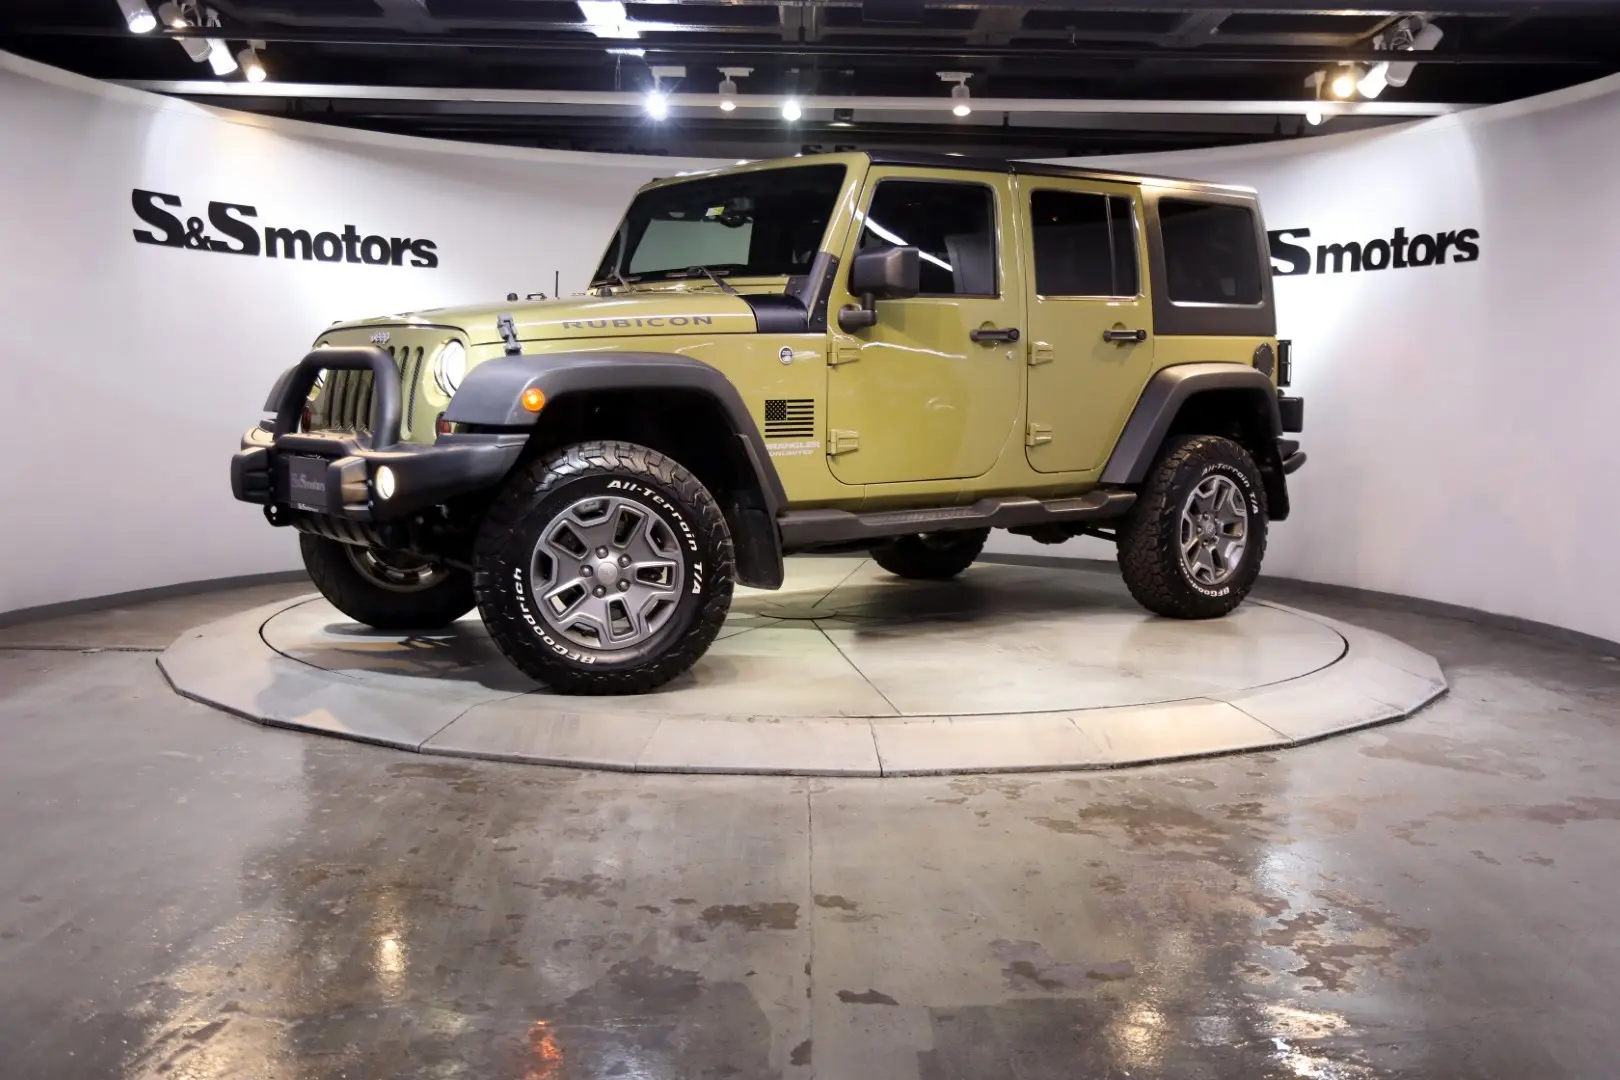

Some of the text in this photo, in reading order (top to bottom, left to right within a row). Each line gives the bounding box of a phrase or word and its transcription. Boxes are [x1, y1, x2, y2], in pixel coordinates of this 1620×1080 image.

[131, 188, 438, 269] S&S motors
[1316, 227, 1480, 274] motors
[562, 315, 713, 330] RUBICON
[1201, 463, 1259, 514] All-Terrain T/A
[606, 480, 703, 594] All-Terrain T/A
[513, 567, 597, 665] BFGoodrich
